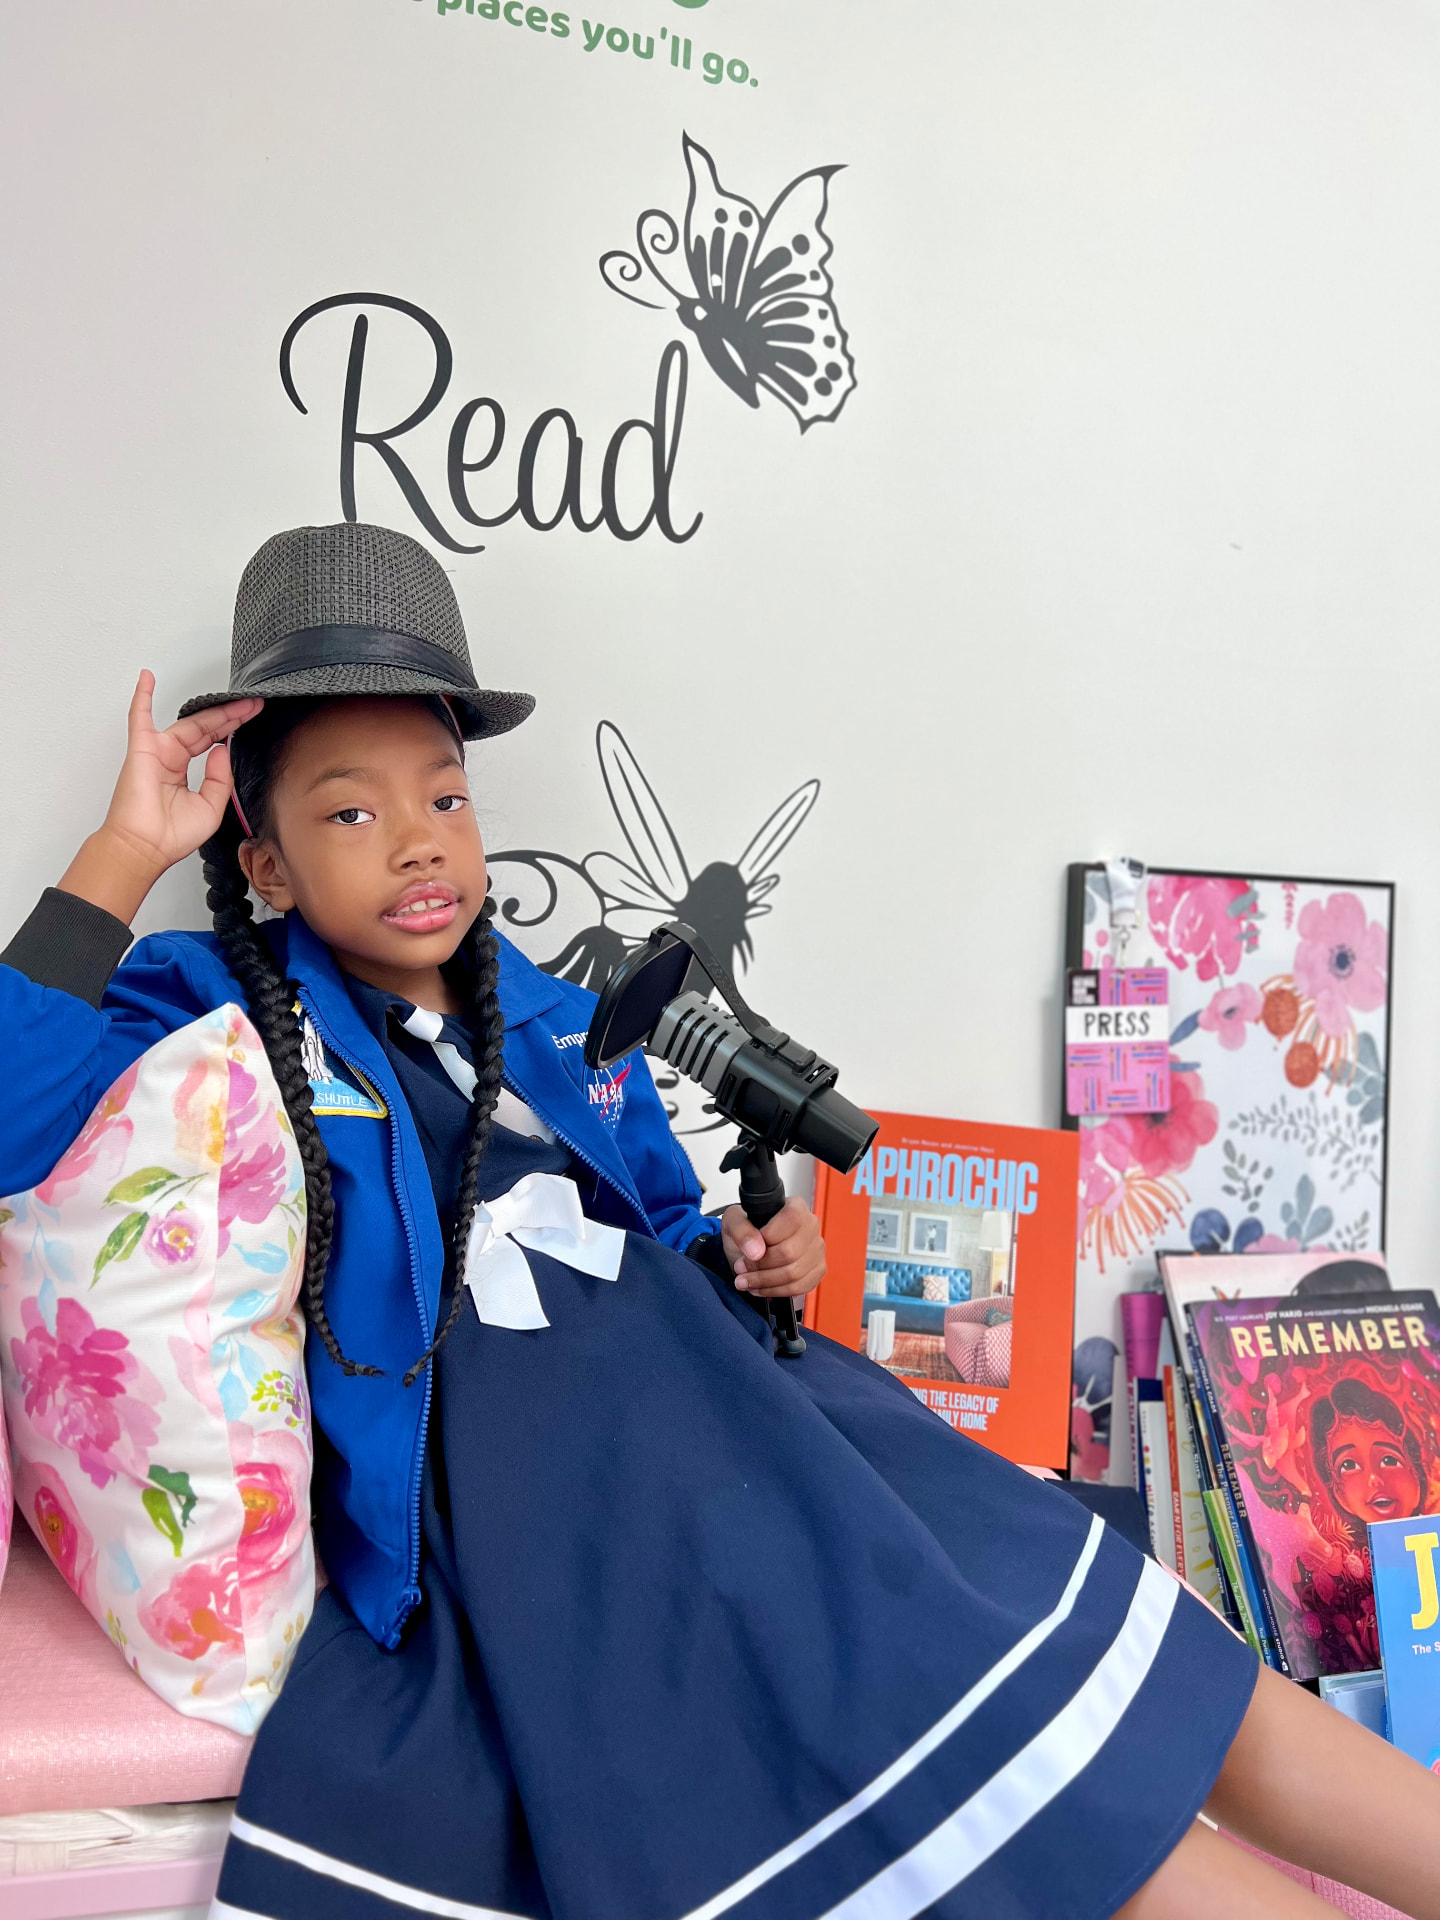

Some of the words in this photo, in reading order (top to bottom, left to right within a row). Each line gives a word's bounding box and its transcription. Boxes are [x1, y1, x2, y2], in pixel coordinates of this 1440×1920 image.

[582, 19, 692, 70] you'll
[702, 52, 759, 87] go.
[280, 292, 703, 554] Read
[1084, 1011, 1150, 1037] PRESS
[551, 1031, 588, 1049] Empr
[316, 1092, 369, 1106] SHUTTLE
[587, 1083, 624, 1104] NASA
[852, 1146, 1038, 1215] APHROCHIC
[1265, 1310, 1277, 1321] JOY
[1230, 1316, 1430, 1358] REMEMBER
[930, 1390, 948, 1408] THE
[949, 1392, 985, 1413] LEGACY
[986, 1397, 1000, 1414] OF
[1206, 1390, 1218, 1413] GOADE
[930, 1408, 960, 1428] MILY
[960, 1411, 988, 1431] HOME
[1221, 1443, 1247, 1518] REMEMBER
[1172, 1490, 1181, 1523] RAMEN
[1216, 1463, 1224, 1480] The
[1231, 1521, 1243, 1548] Guest
[1174, 1523, 1183, 1543] FOR
[1176, 1544, 1187, 1579] EVERY
[1270, 1616, 1279, 1637] HOUSE
[1276, 1637, 1285, 1660] STUDIO
[1412, 1644, 1432, 1656] The
